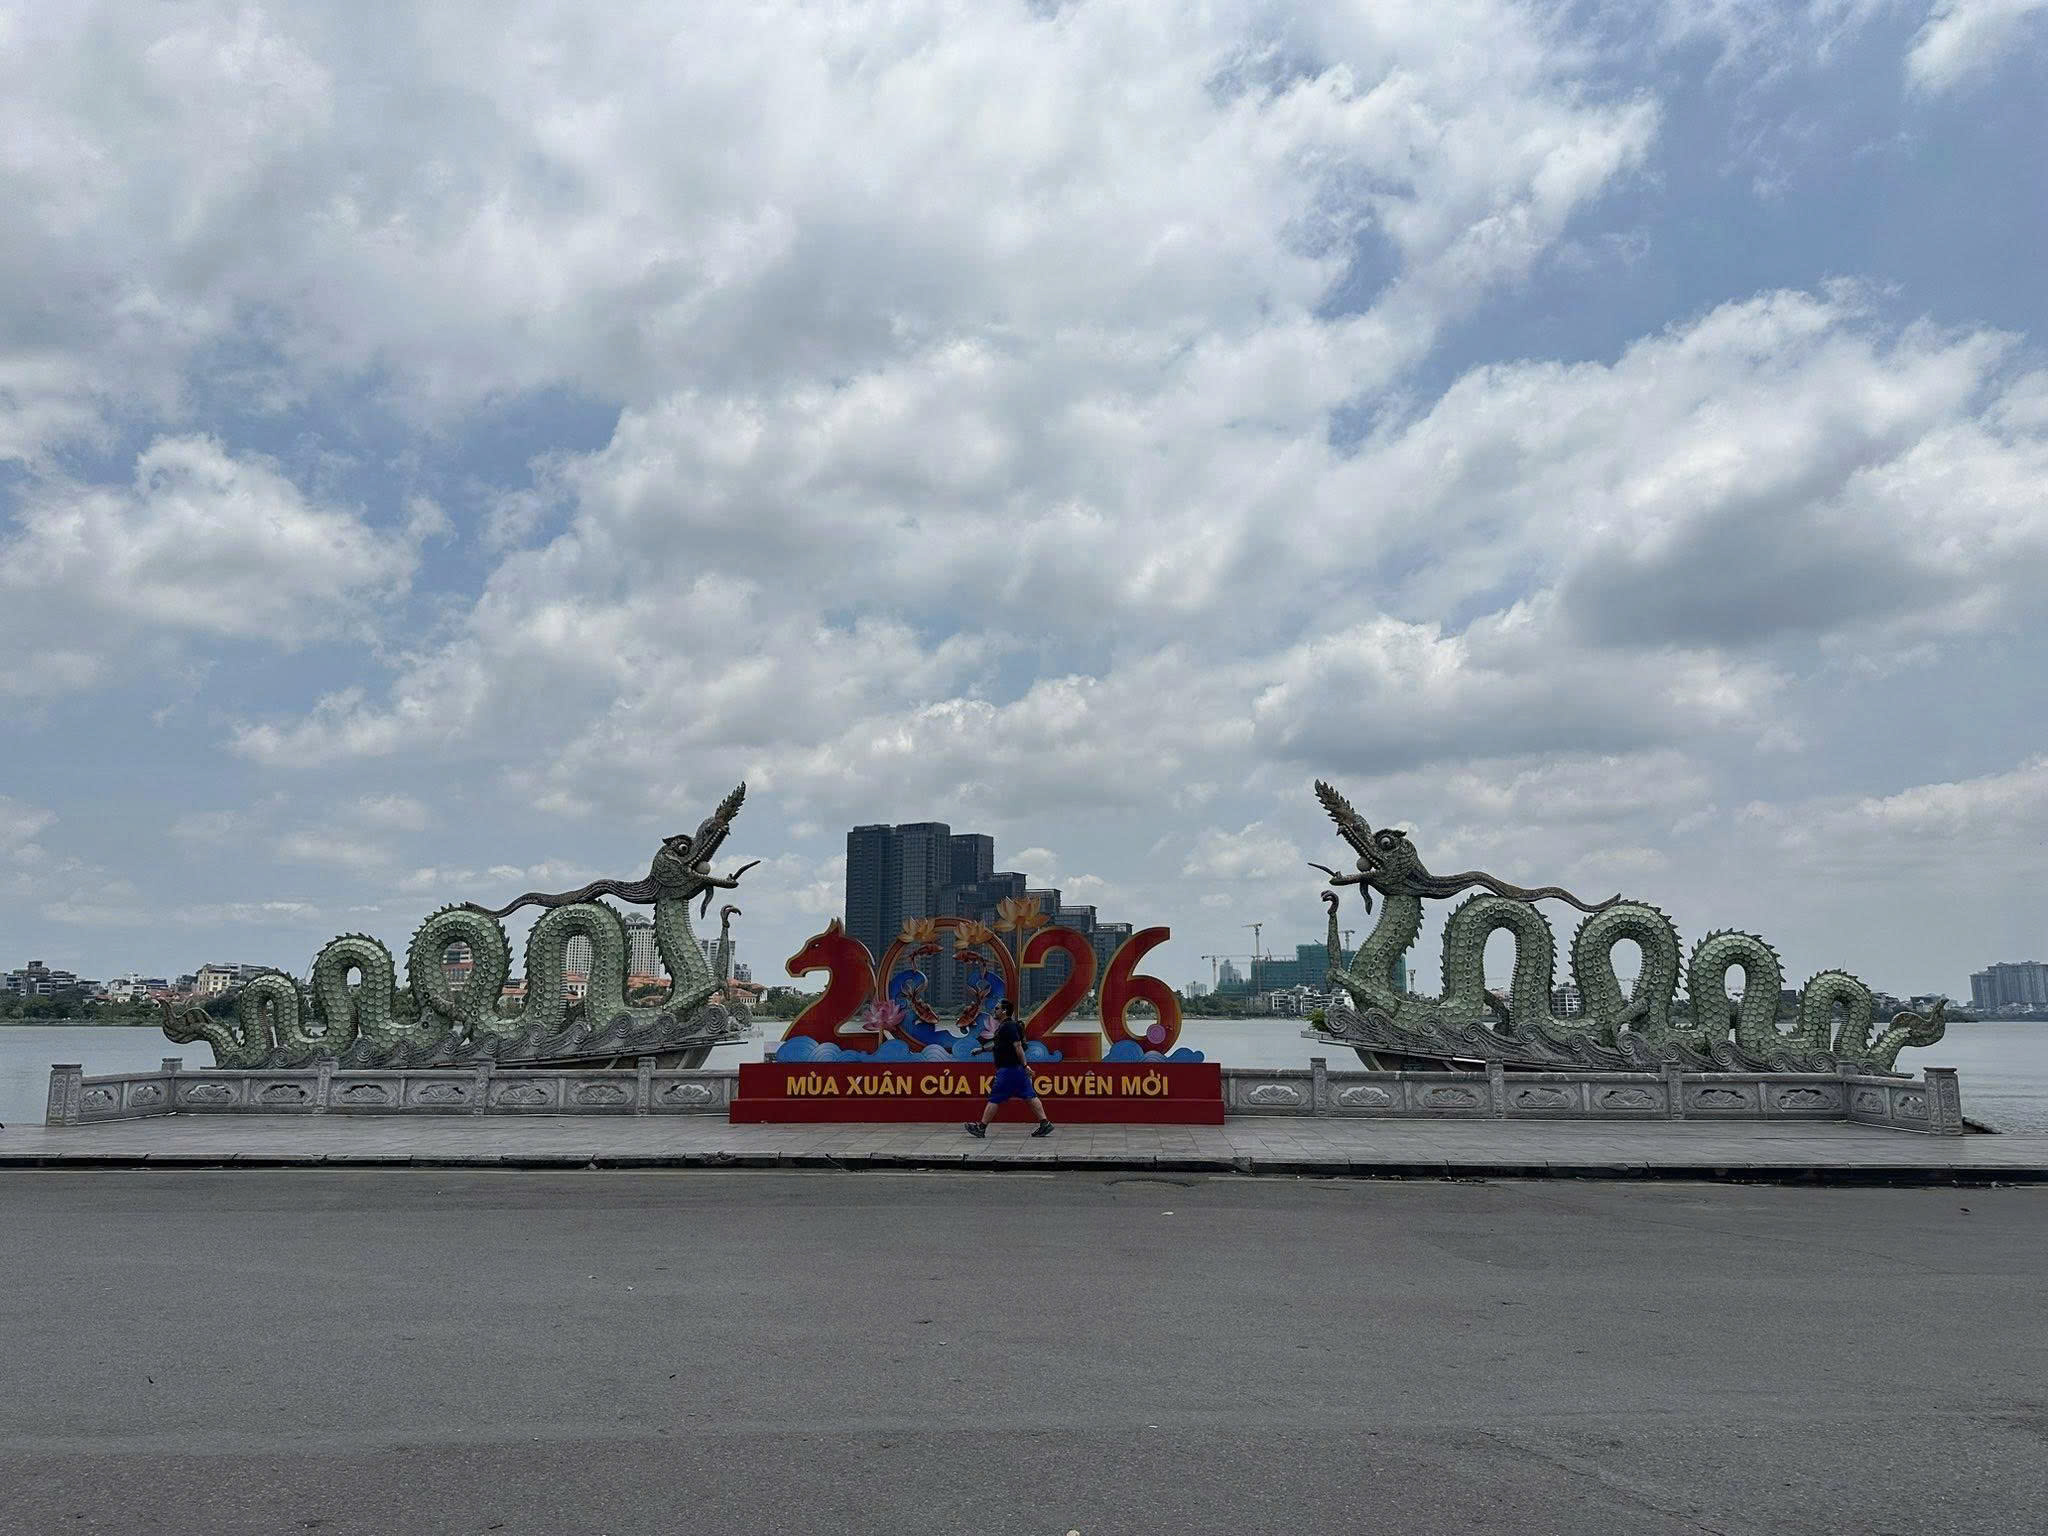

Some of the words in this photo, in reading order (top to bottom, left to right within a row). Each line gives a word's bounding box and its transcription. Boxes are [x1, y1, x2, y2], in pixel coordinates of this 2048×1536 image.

[783, 916, 1183, 1061] 2026
[787, 1071, 839, 1095] MÙA
[846, 1070, 912, 1095] XUÂN
[920, 1069, 971, 1095] CỦA
[1033, 1070, 1113, 1096] GUYÊN
